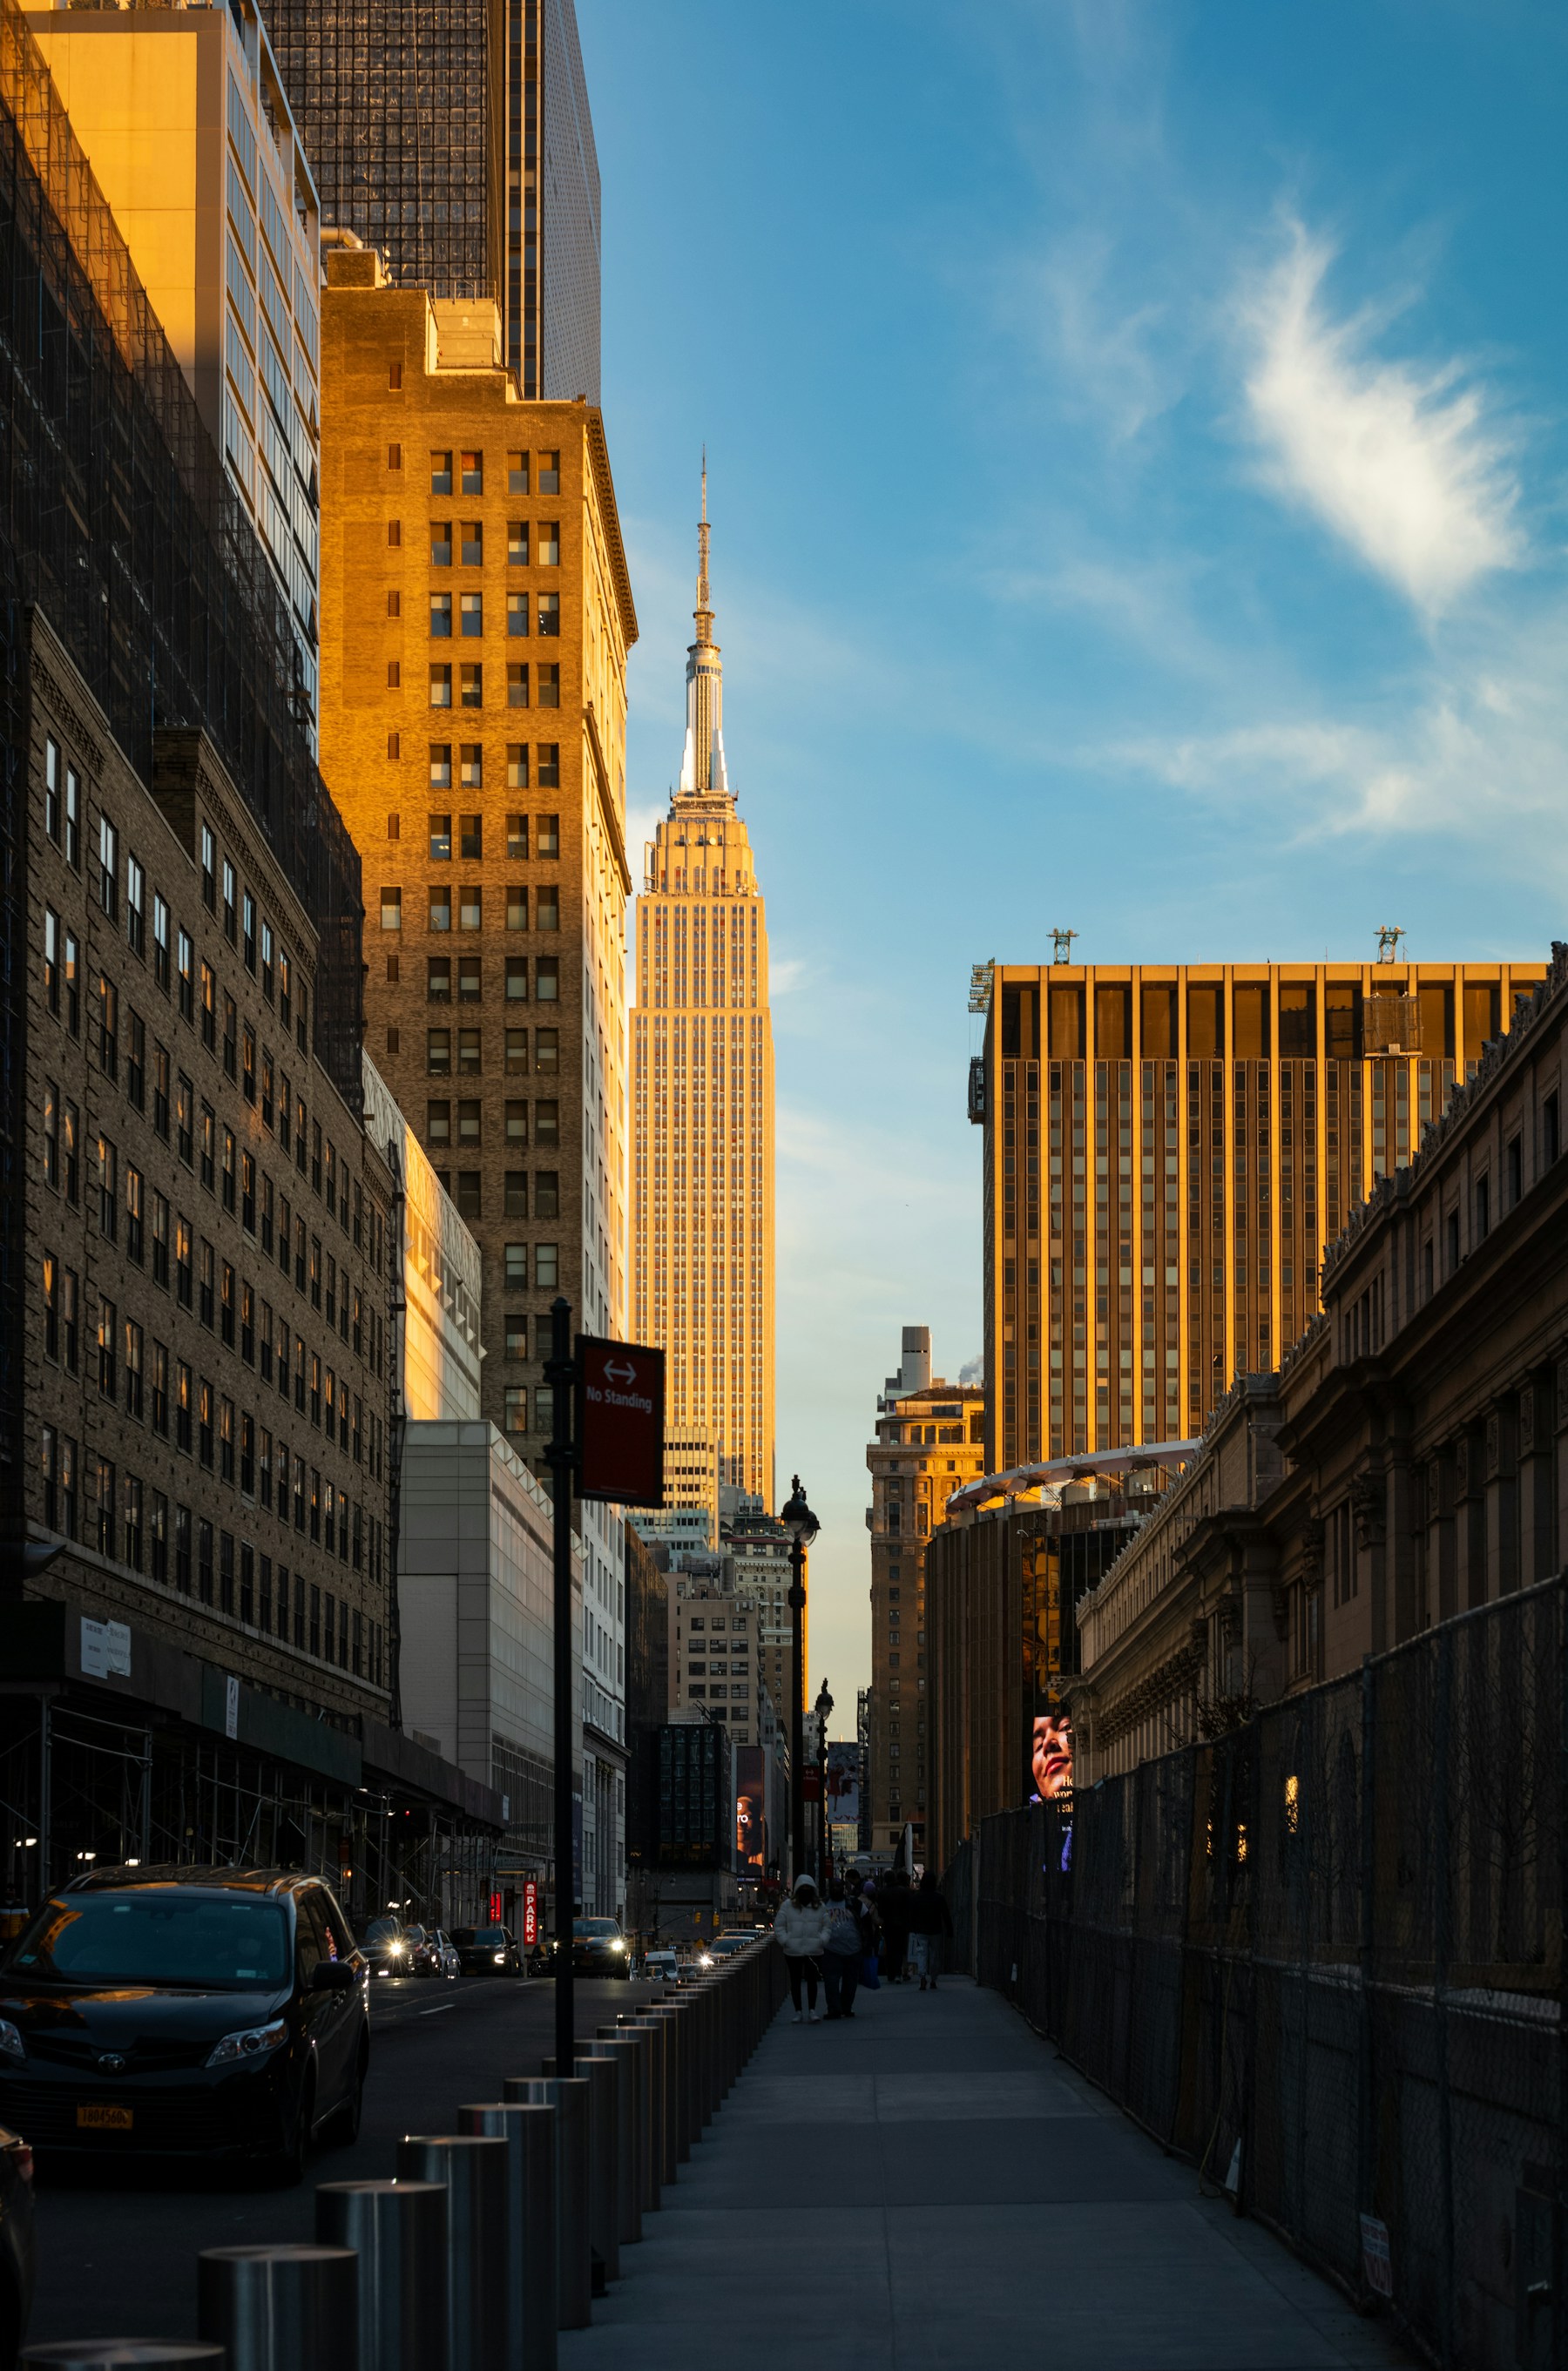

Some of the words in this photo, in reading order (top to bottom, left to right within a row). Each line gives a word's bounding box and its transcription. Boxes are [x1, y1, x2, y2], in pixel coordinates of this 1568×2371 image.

[586, 1386, 602, 1402] No
[605, 1389, 652, 1414] Standing
[526, 1895, 535, 1934] PARK
